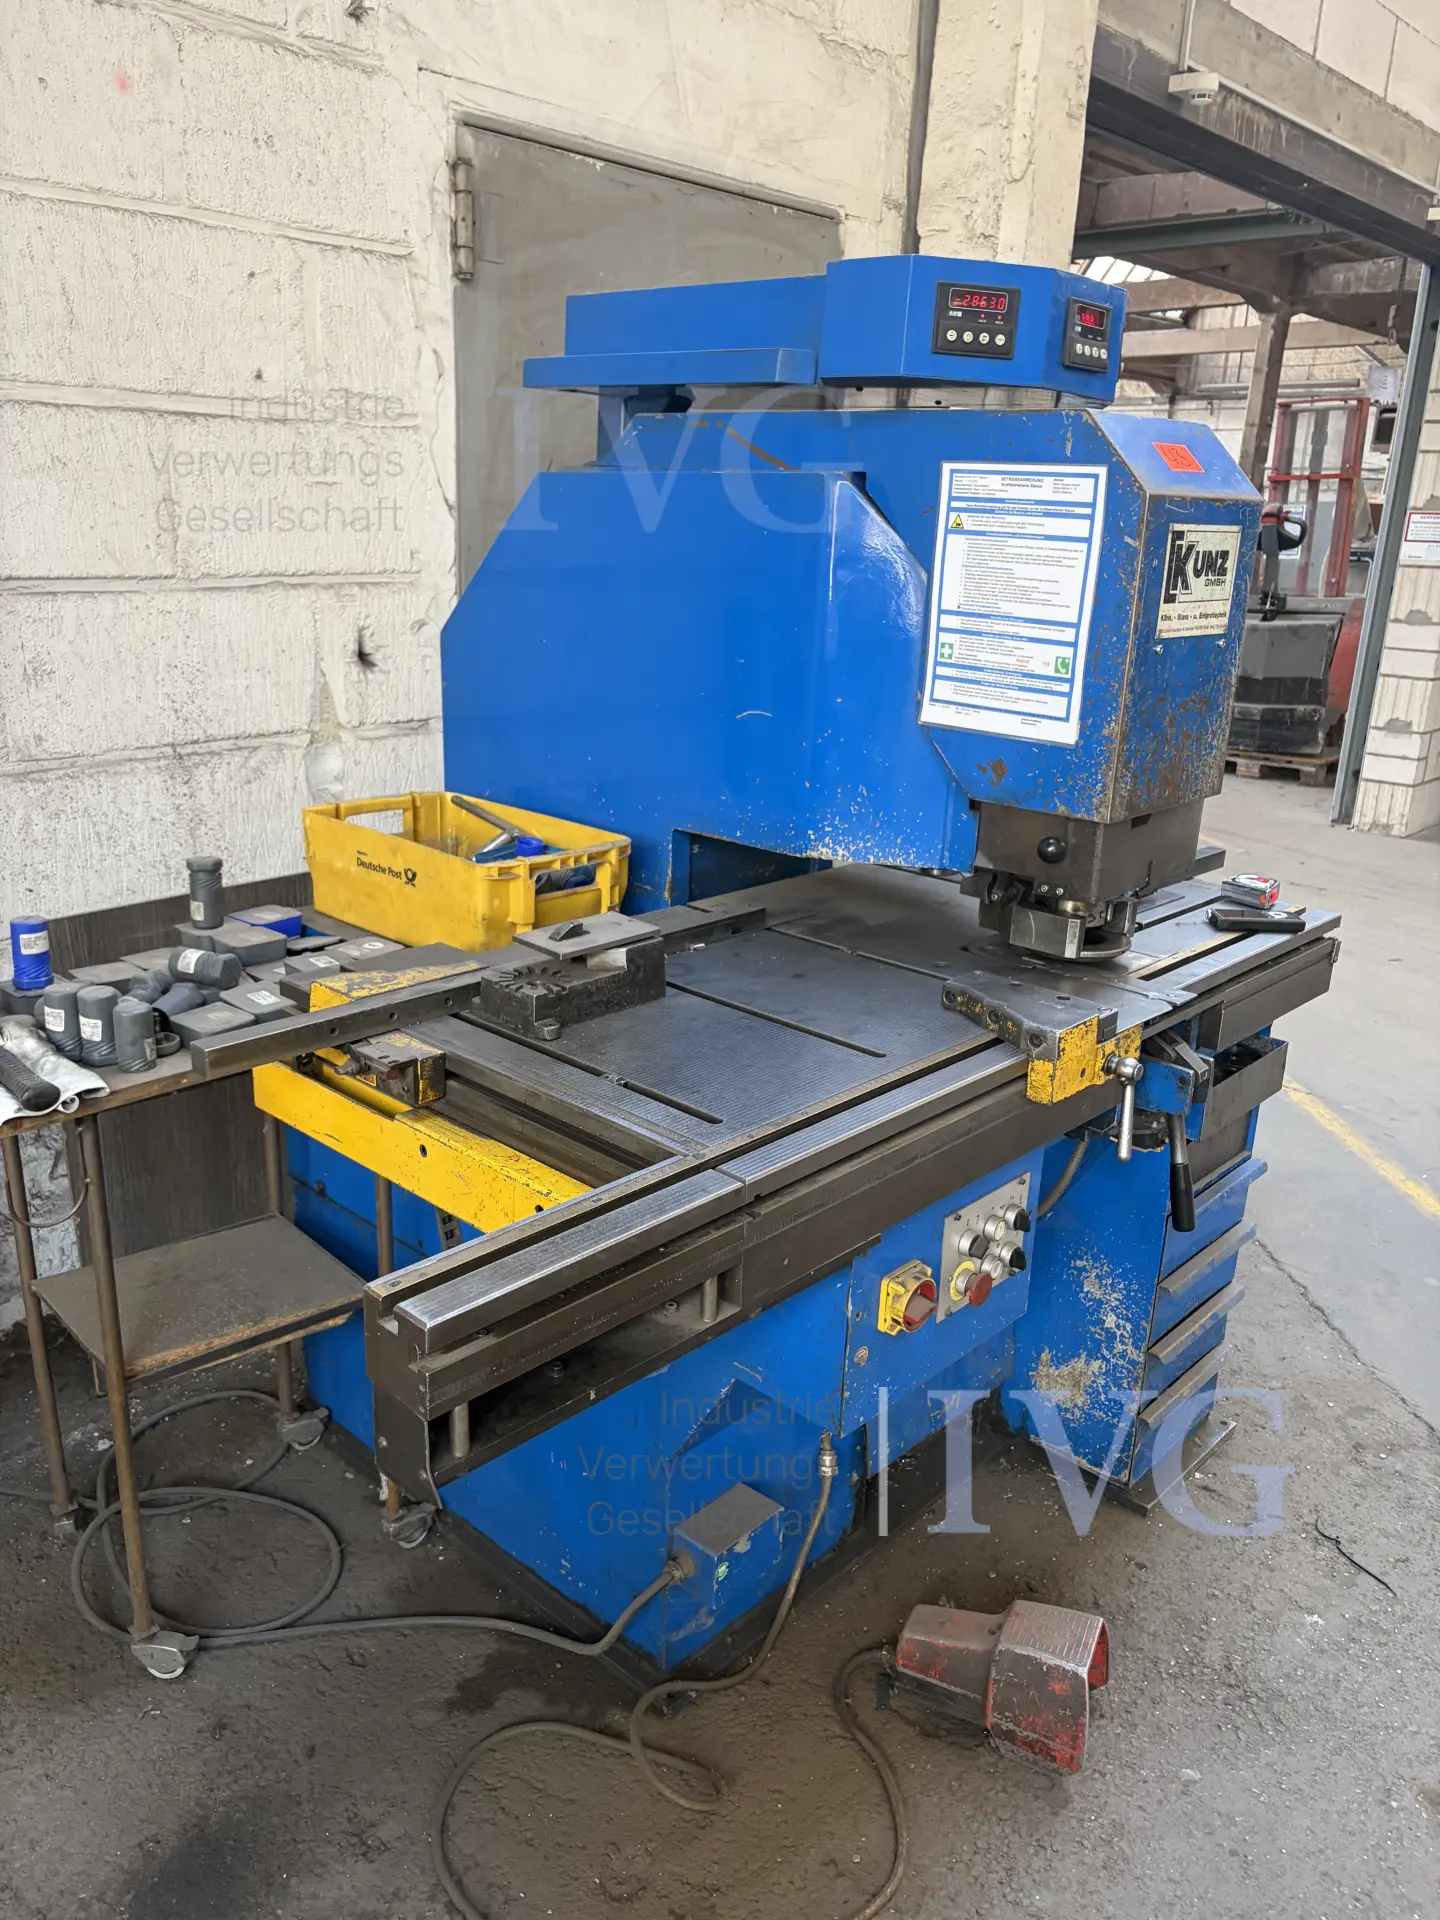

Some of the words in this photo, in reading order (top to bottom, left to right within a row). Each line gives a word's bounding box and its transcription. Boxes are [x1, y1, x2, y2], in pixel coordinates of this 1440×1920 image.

[1168, 540, 1230, 594] KUNZ
[1204, 578, 1226, 587] GMBH
[356, 856, 387, 875] Deutsche
[387, 866, 402, 880] Post
